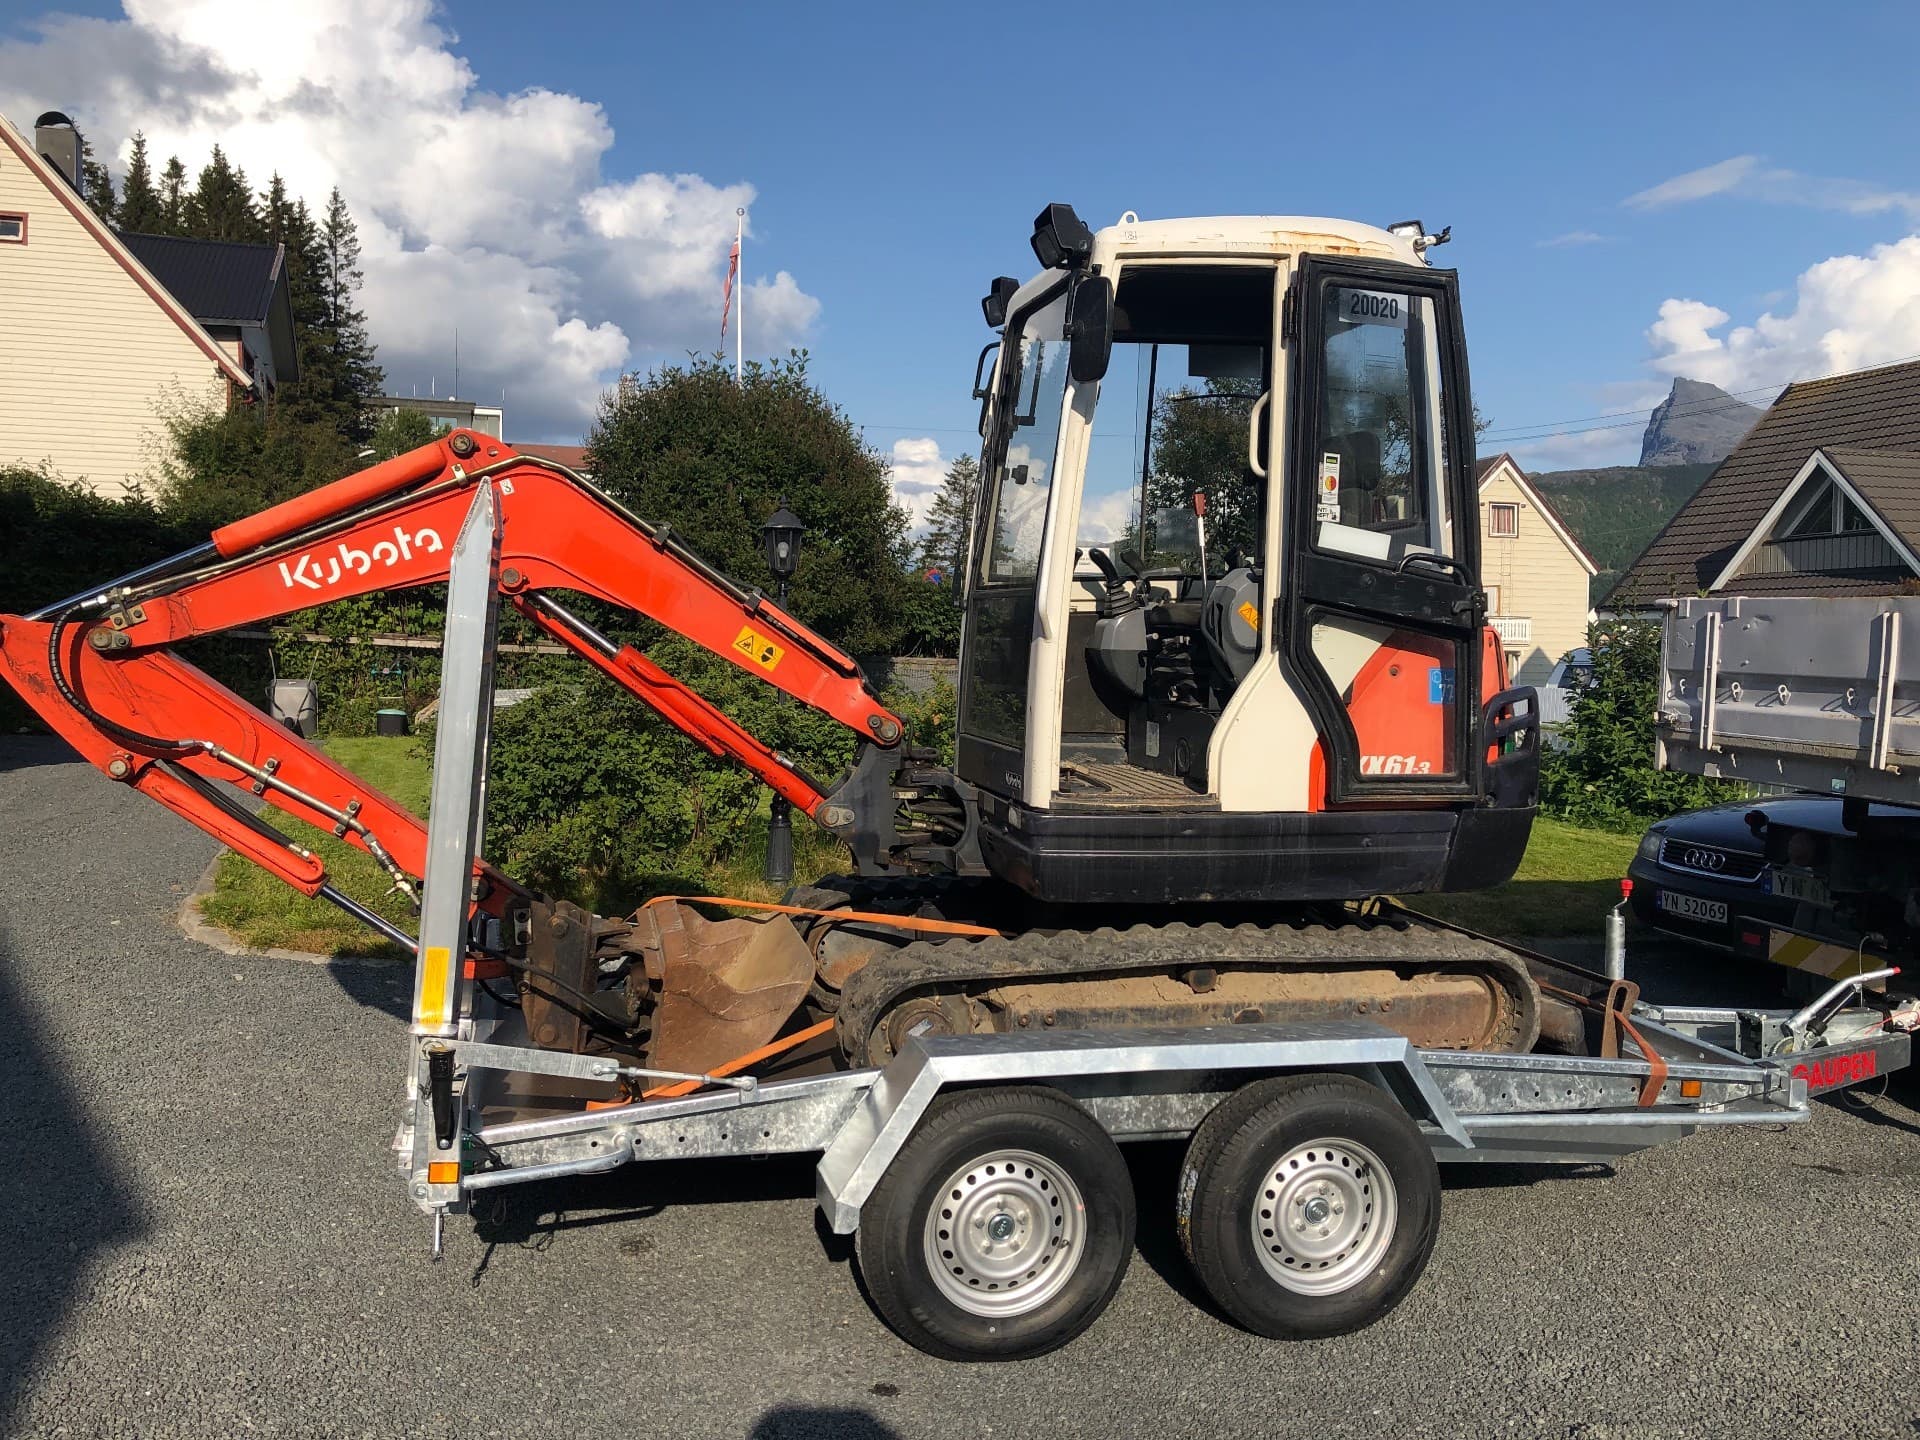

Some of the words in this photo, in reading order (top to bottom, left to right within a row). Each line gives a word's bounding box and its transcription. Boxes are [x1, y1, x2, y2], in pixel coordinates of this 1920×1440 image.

[1350, 292, 1399, 320] 20020
[278, 526, 444, 590] Kubota
[1663, 892, 1679, 911] YN
[1684, 898, 1726, 920] 52069
